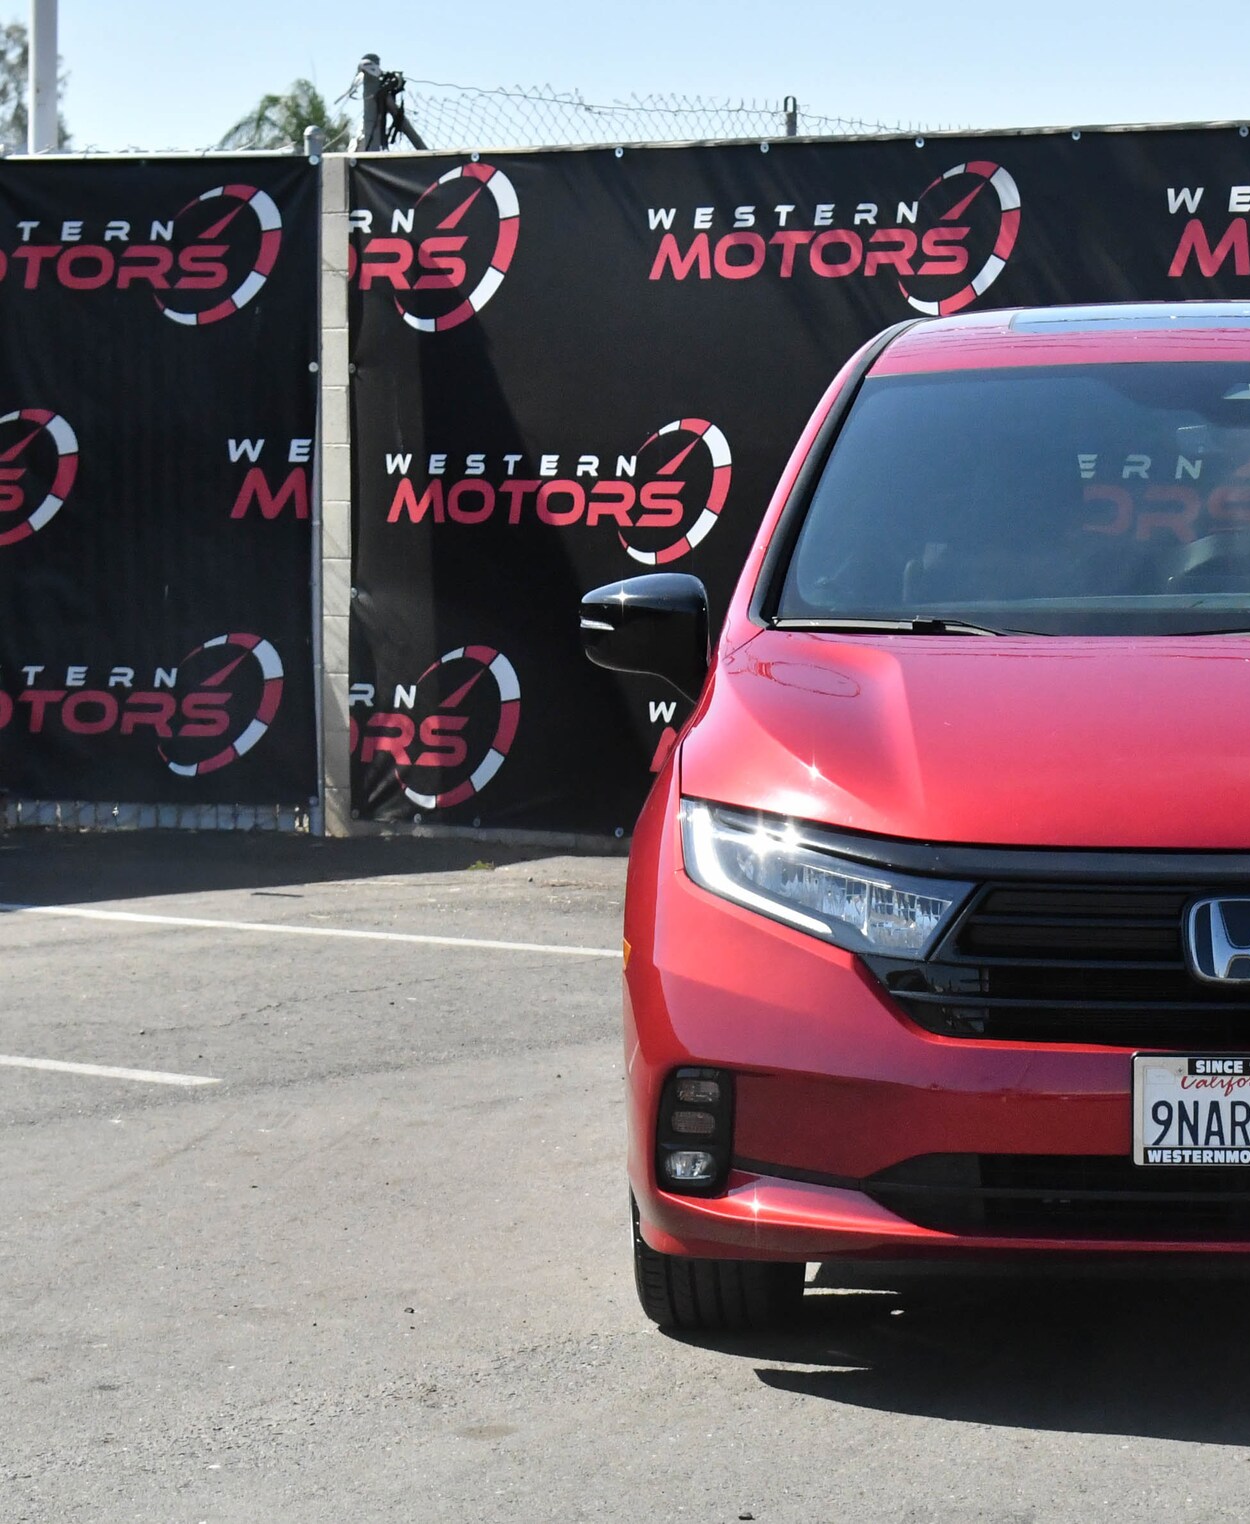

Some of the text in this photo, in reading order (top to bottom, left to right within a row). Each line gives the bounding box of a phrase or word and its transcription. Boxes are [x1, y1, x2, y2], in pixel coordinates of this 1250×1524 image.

[648, 201, 919, 230] WESTERN
[0, 245, 231, 290] TORS
[649, 226, 971, 280] MOTORS
[386, 453, 638, 477] WESTERN
[387, 478, 686, 527] MOTORS
[1195, 1060, 1244, 1074] SINCE
